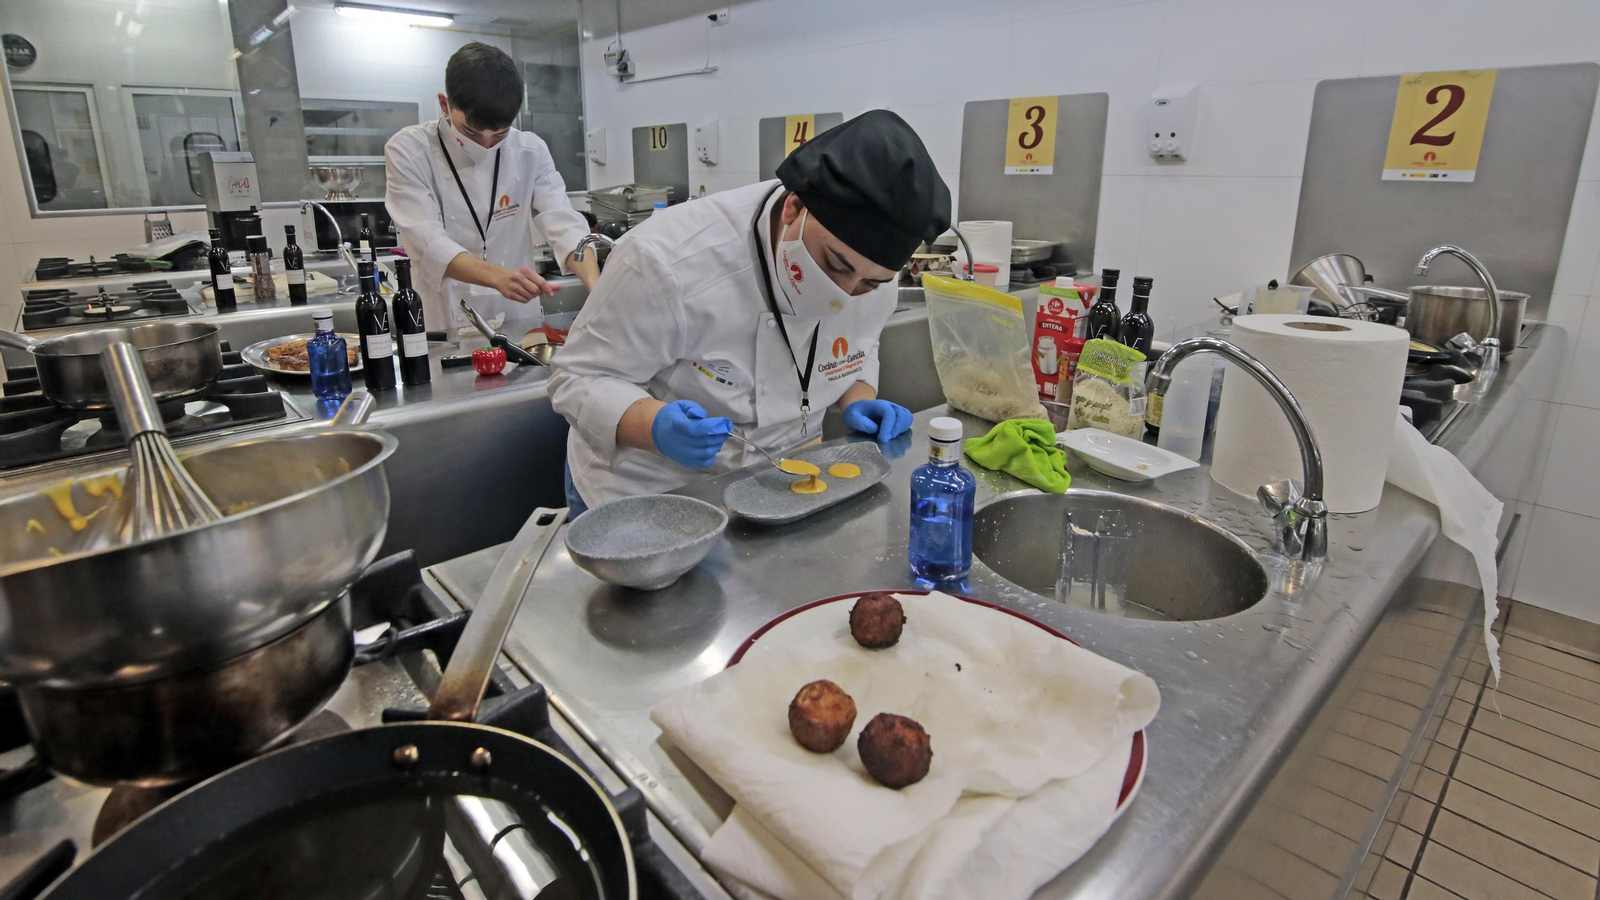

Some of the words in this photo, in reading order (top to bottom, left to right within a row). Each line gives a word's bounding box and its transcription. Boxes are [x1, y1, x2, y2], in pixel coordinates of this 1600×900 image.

[1409, 84, 1466, 147] 2
[651, 126, 668, 149] 10
[793, 121, 808, 146] 4
[1018, 105, 1046, 150] 3
[1041, 322, 1064, 332] ENTERA
[817, 361, 838, 373] Cocina
[828, 374, 842, 382] PAULA
